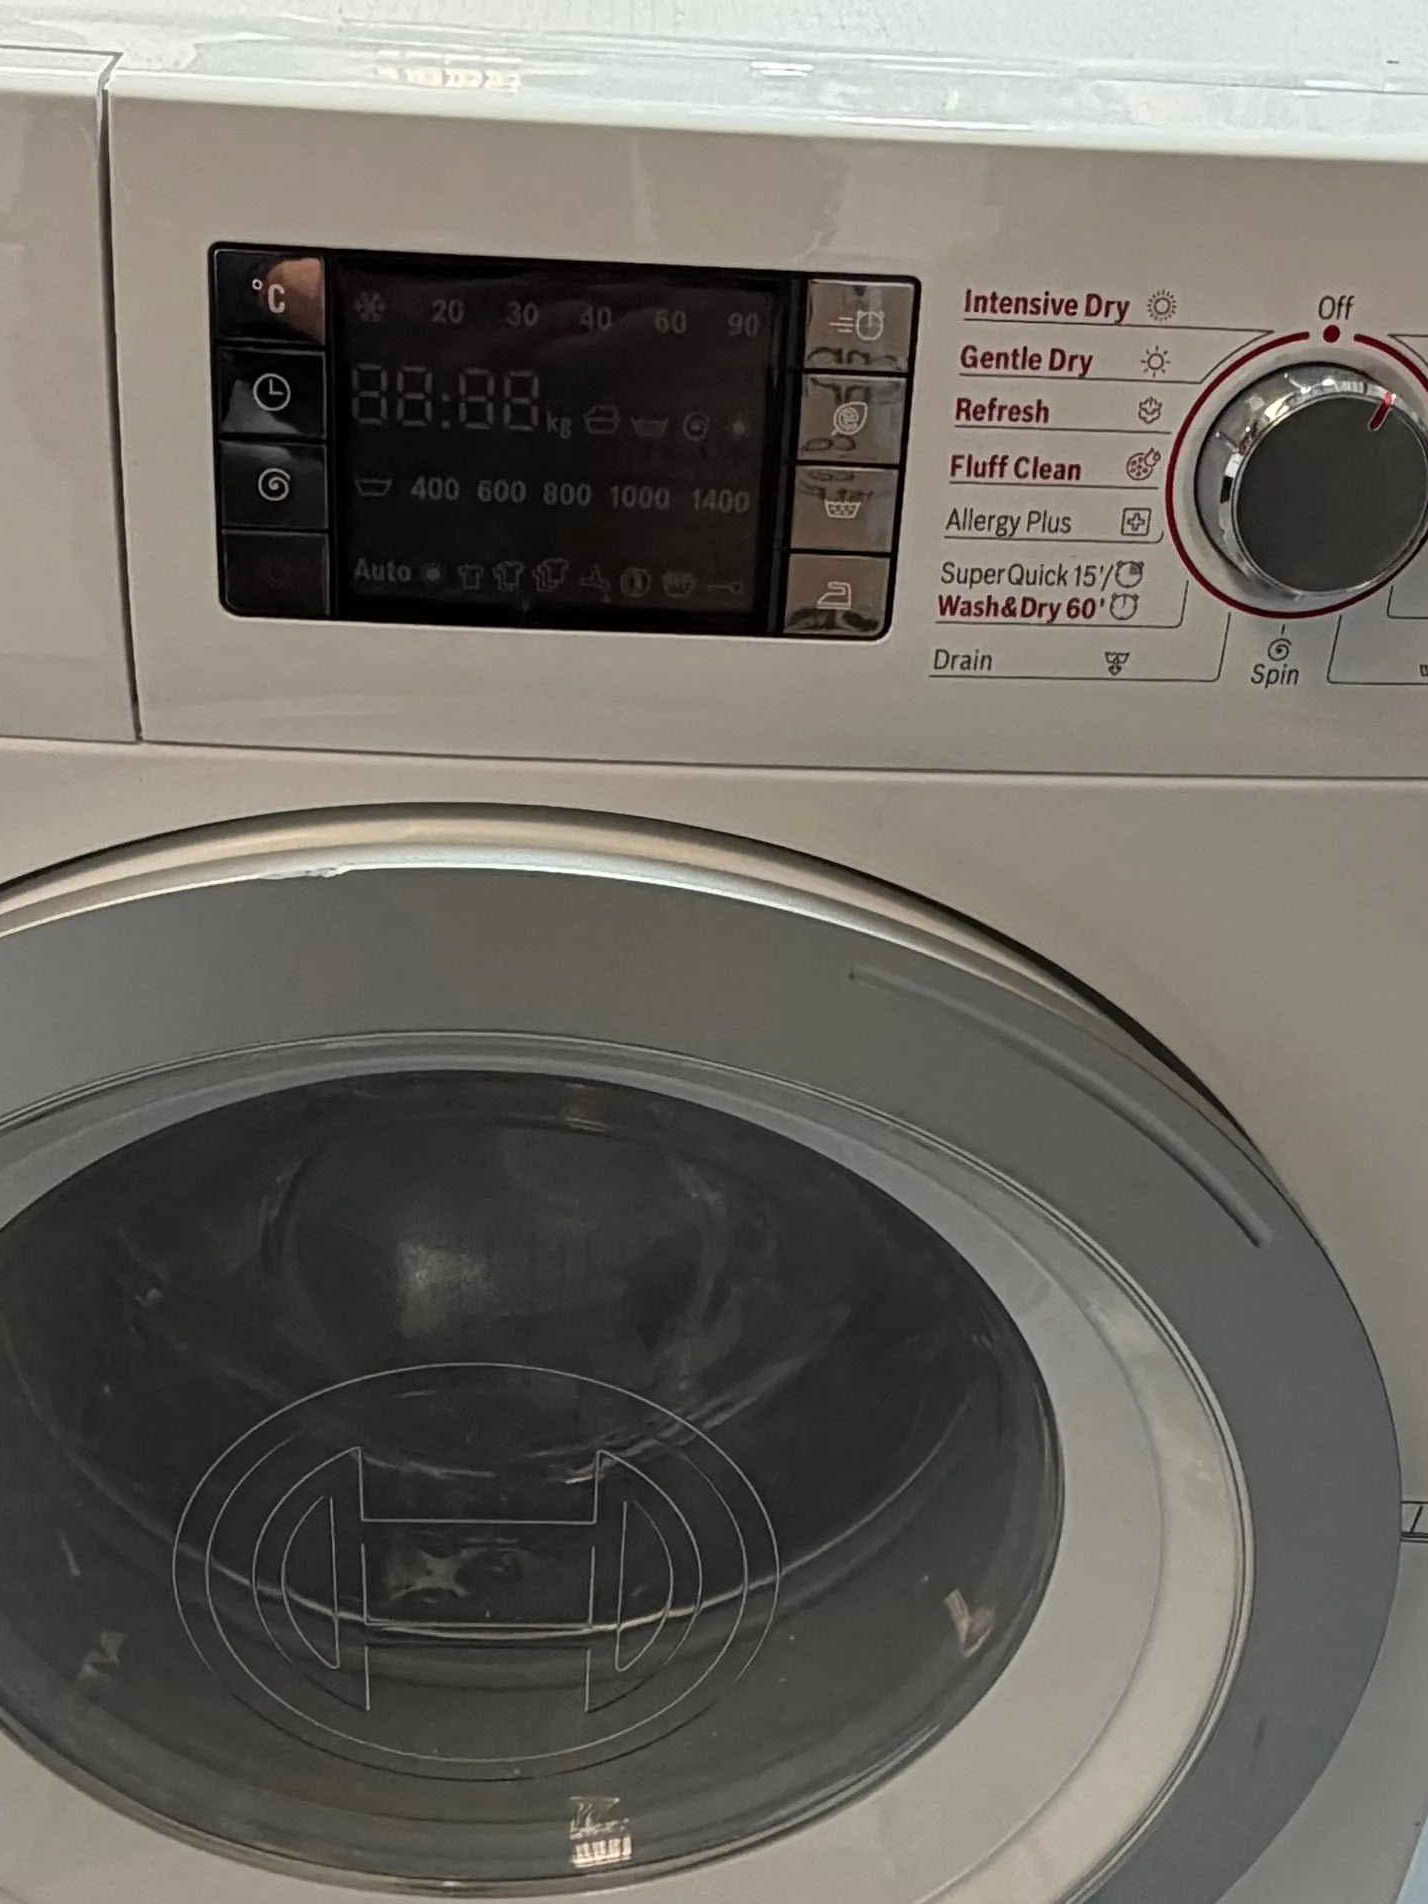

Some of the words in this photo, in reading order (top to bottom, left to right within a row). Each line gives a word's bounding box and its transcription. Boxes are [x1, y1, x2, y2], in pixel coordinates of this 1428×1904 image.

[431, 299, 464, 324] 20
[505, 301, 540, 327] 30
[579, 304, 613, 332] 40
[654, 309, 688, 334] 60
[727, 312, 761, 337] 90
[964, 288, 1079, 316] Intensive
[1084, 293, 1130, 324] Dry
[1318, 295, 1355, 320] Off
[960, 345, 1043, 371] Gentle
[1048, 347, 1094, 378] Dry
[955, 397, 1050, 424] Refresh
[547, 414, 572, 440] kg
[950, 453, 1009, 478] Fluff
[1013, 455, 1082, 482] Clean
[410, 477, 460, 500] 400
[477, 480, 527, 503] 600
[542, 482, 593, 507] 800
[610, 485, 671, 510] 1000
[692, 488, 751, 513] 1400
[945, 507, 1021, 537] Allergy
[1026, 509, 1072, 534] Plus
[353, 557, 412, 583] Auto
[938, 594, 1062, 624] Wash&Dry
[933, 648, 993, 671] Drain
[1251, 663, 1299, 689] Spin
